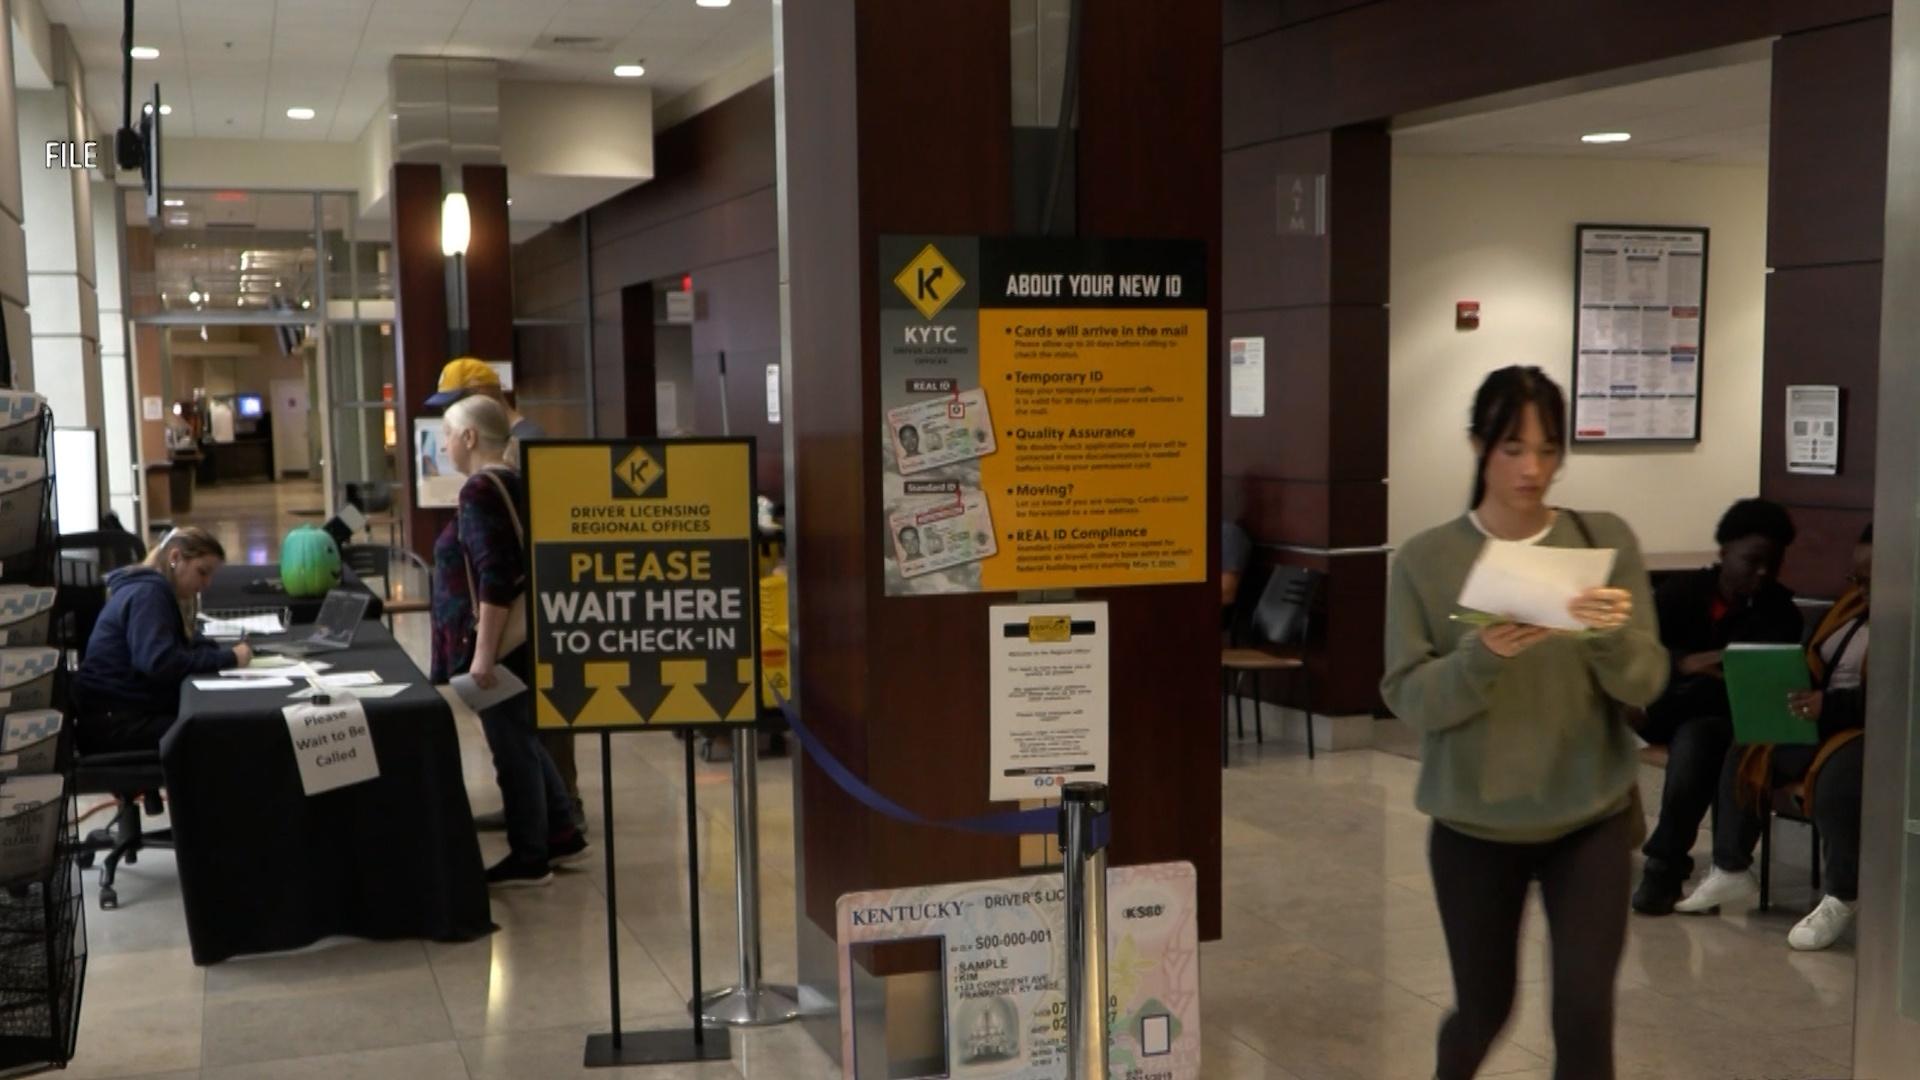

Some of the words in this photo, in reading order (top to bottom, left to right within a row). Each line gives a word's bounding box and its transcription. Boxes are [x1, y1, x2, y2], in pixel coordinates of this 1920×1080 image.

[1006, 274, 1063, 297] ABOUT
[1069, 274, 1114, 297] YOUR
[1119, 274, 1159, 297] NEW
[1166, 274, 1181, 297] ID
[904, 326, 957, 344] KYTC
[1015, 325, 1053, 337] Cards
[1056, 325, 1078, 337] will
[1082, 325, 1117, 337] arrive
[1122, 325, 1133, 336] in
[1137, 325, 1158, 337] the
[1161, 325, 1188, 337] mail
[1015, 371, 1086, 384] Temporary
[1090, 371, 1103, 382] ID
[913, 382, 937, 391] REAL
[1016, 428, 1064, 441] Quality
[1069, 428, 1135, 438] Assurance
[1016, 484, 1074, 497] Moving?
[571, 505, 625, 519] DRIVER
[630, 504, 711, 518] LICENSING
[571, 520, 647, 534] REGIONAL
[652, 519, 711, 533] OFFICES
[1017, 529, 1050, 541] REAL
[1054, 529, 1066, 540] ID
[1071, 527, 1148, 542] Compliance
[570, 550, 712, 584] PLEASE
[541, 590, 637, 625] WAIT
[646, 588, 741, 622] HERE
[551, 630, 591, 654] TO
[598, 627, 736, 653] CHECK-IN
[304, 710, 347, 727] Please
[295, 735, 328, 750] Wait
[331, 731, 346, 742] to
[348, 725, 367, 738] Be
[315, 748, 357, 767] Called
[852, 901, 964, 925] KENTUCKY
[985, 891, 1042, 909] DRIVER'S
[975, 929, 1052, 950] S00-000-001
[958, 959, 1008, 973] SAMPLE
[958, 972, 978, 982] KIM
